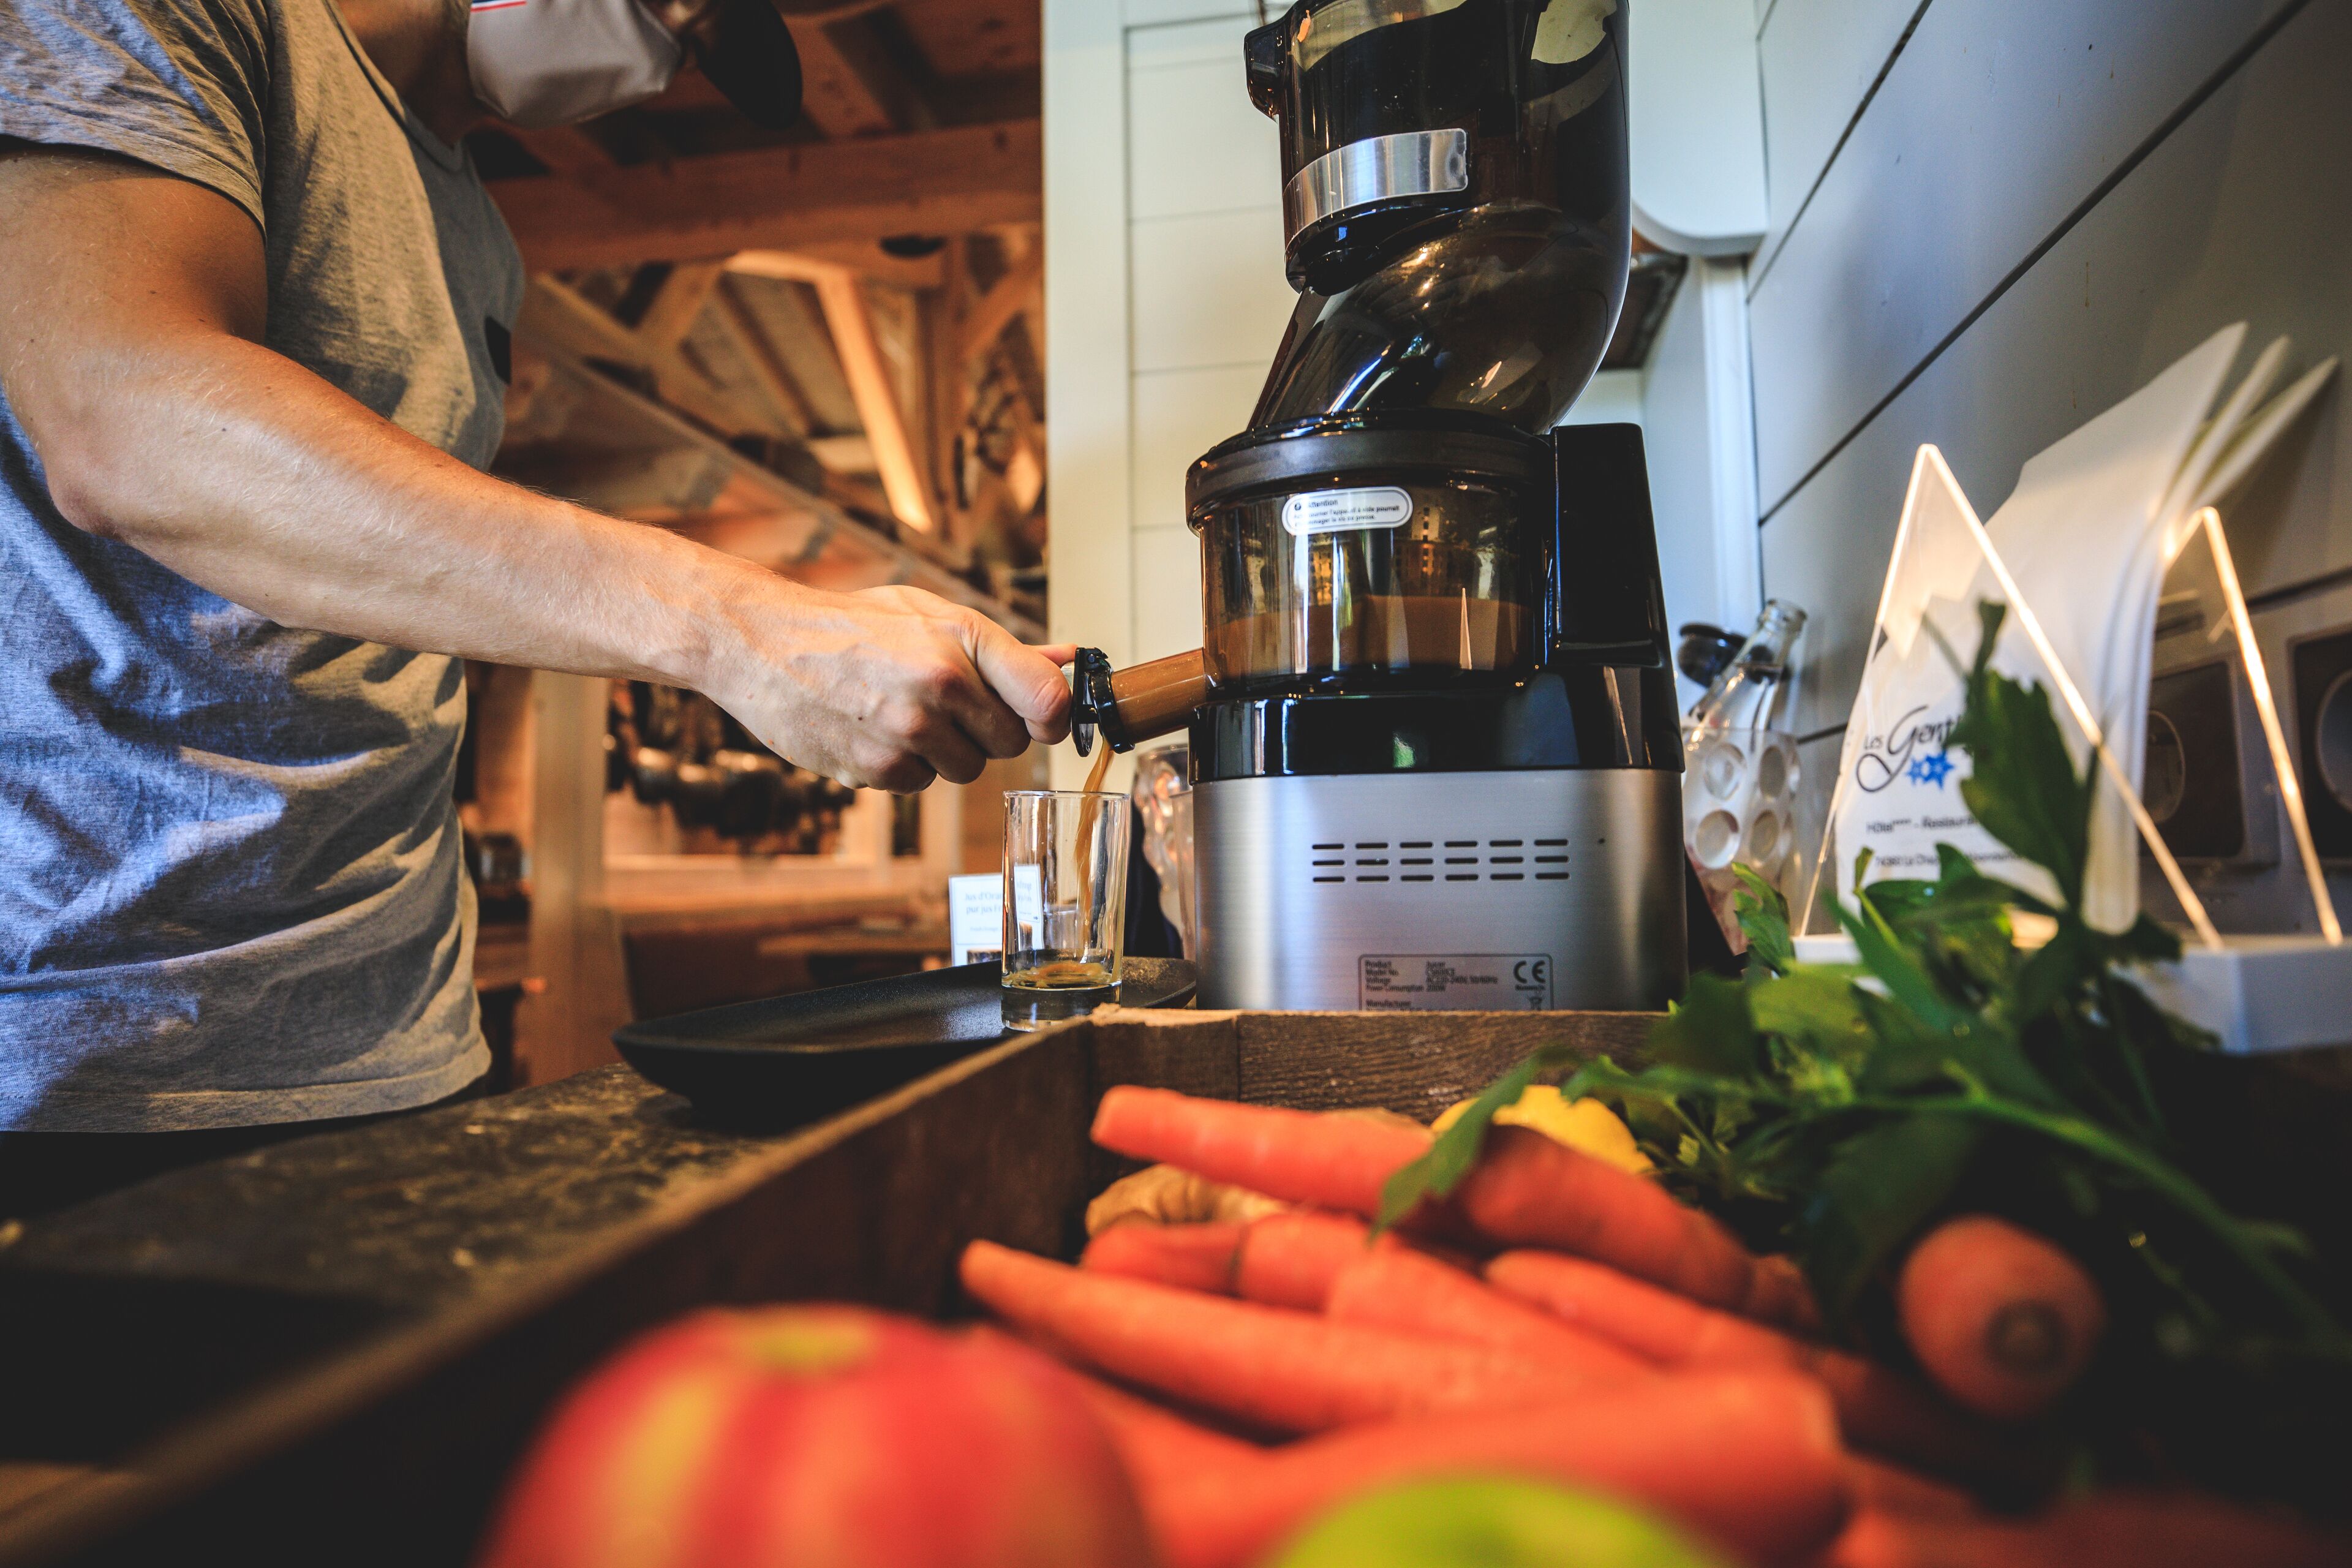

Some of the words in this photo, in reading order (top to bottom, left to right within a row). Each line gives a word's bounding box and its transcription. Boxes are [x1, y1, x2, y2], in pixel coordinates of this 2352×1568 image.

[1308, 499, 1338, 508] Attention
[1376, 505, 1400, 513] pourrait
[1863, 735, 1883, 750] Les
[965, 892, 976, 901] Jus
[966, 906, 978, 915] pur
[981, 905, 992, 914] jus
